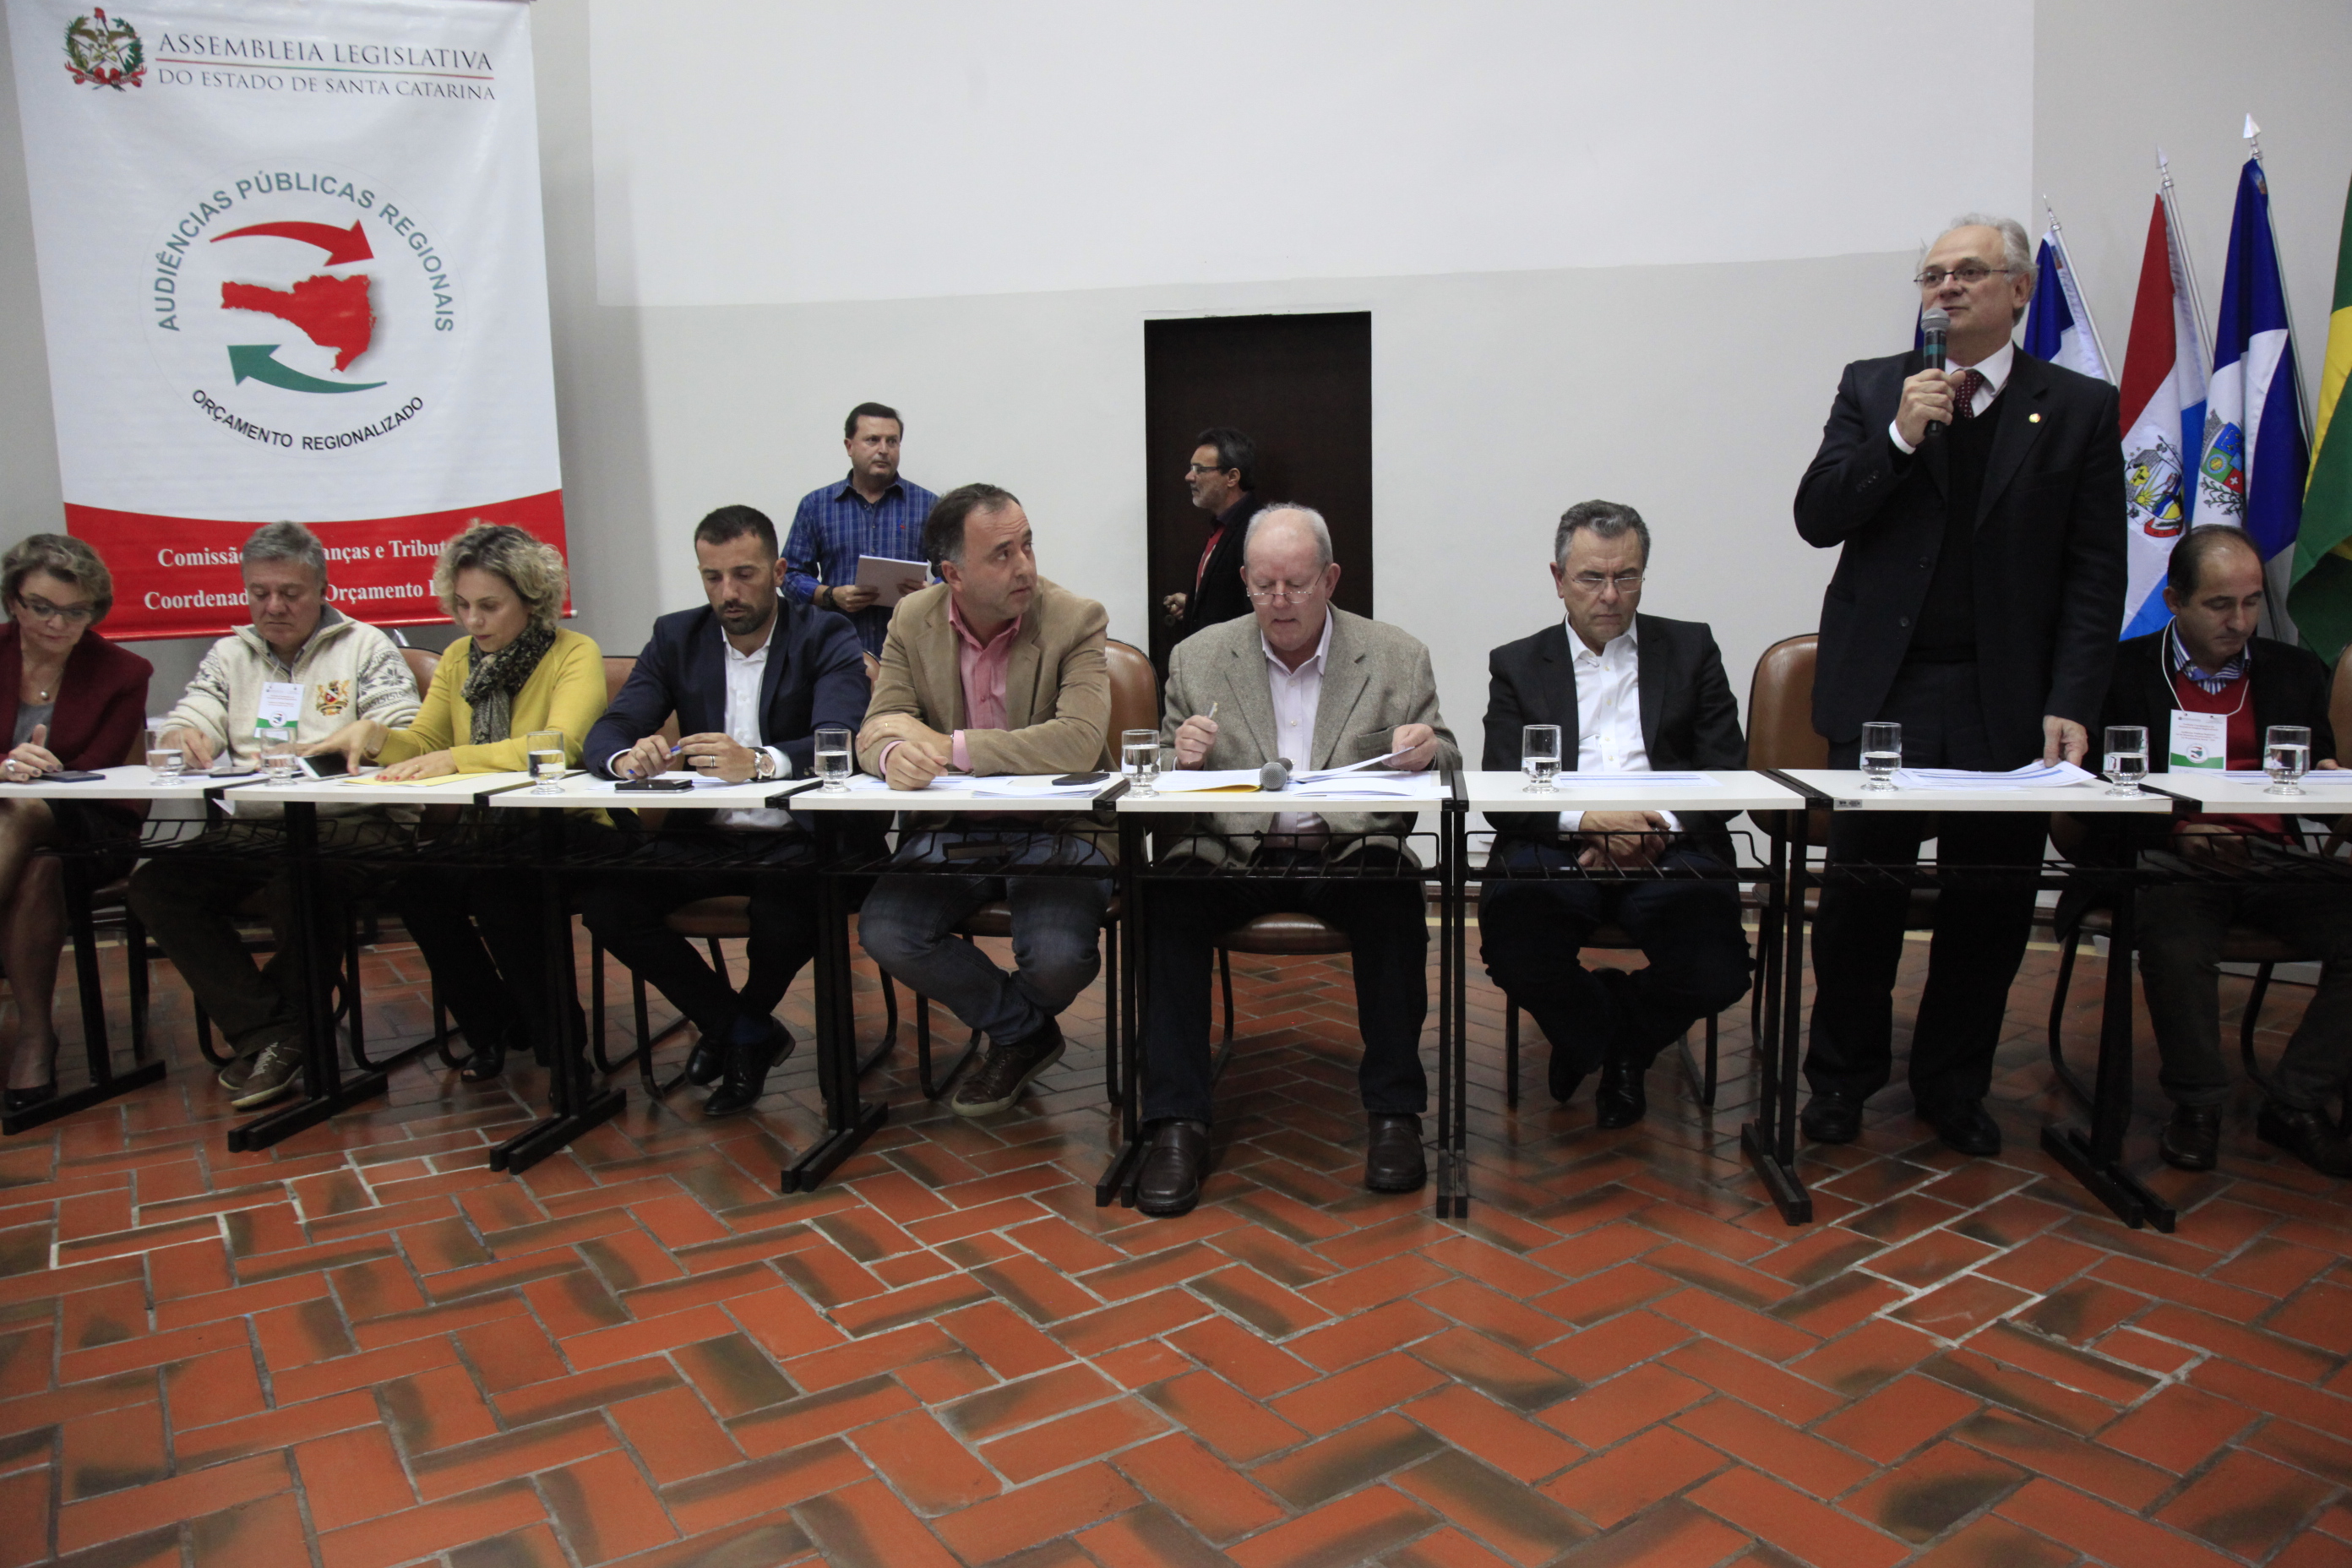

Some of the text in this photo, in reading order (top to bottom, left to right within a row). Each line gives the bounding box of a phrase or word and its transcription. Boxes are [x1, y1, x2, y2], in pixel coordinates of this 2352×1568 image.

[159, 33, 493, 71] ASSEMBLEIA LEGISLATIVA
[159, 68, 193, 85] DO
[202, 71, 284, 90] ESTADO
[291, 77, 318, 92] DE
[325, 78, 390, 95] SANTA
[395, 80, 496, 101] CATARINA
[154, 170, 455, 332] AUDIÊNCIAS PÚBLICAS REGIONAIS
[192, 389, 424, 450] ORÇAMENTO REGIONALIZADO
[158, 539, 447, 568] Comissã anças e Tribut
[144, 588, 250, 610] Coordenad
[324, 581, 423, 604] Orçamento
